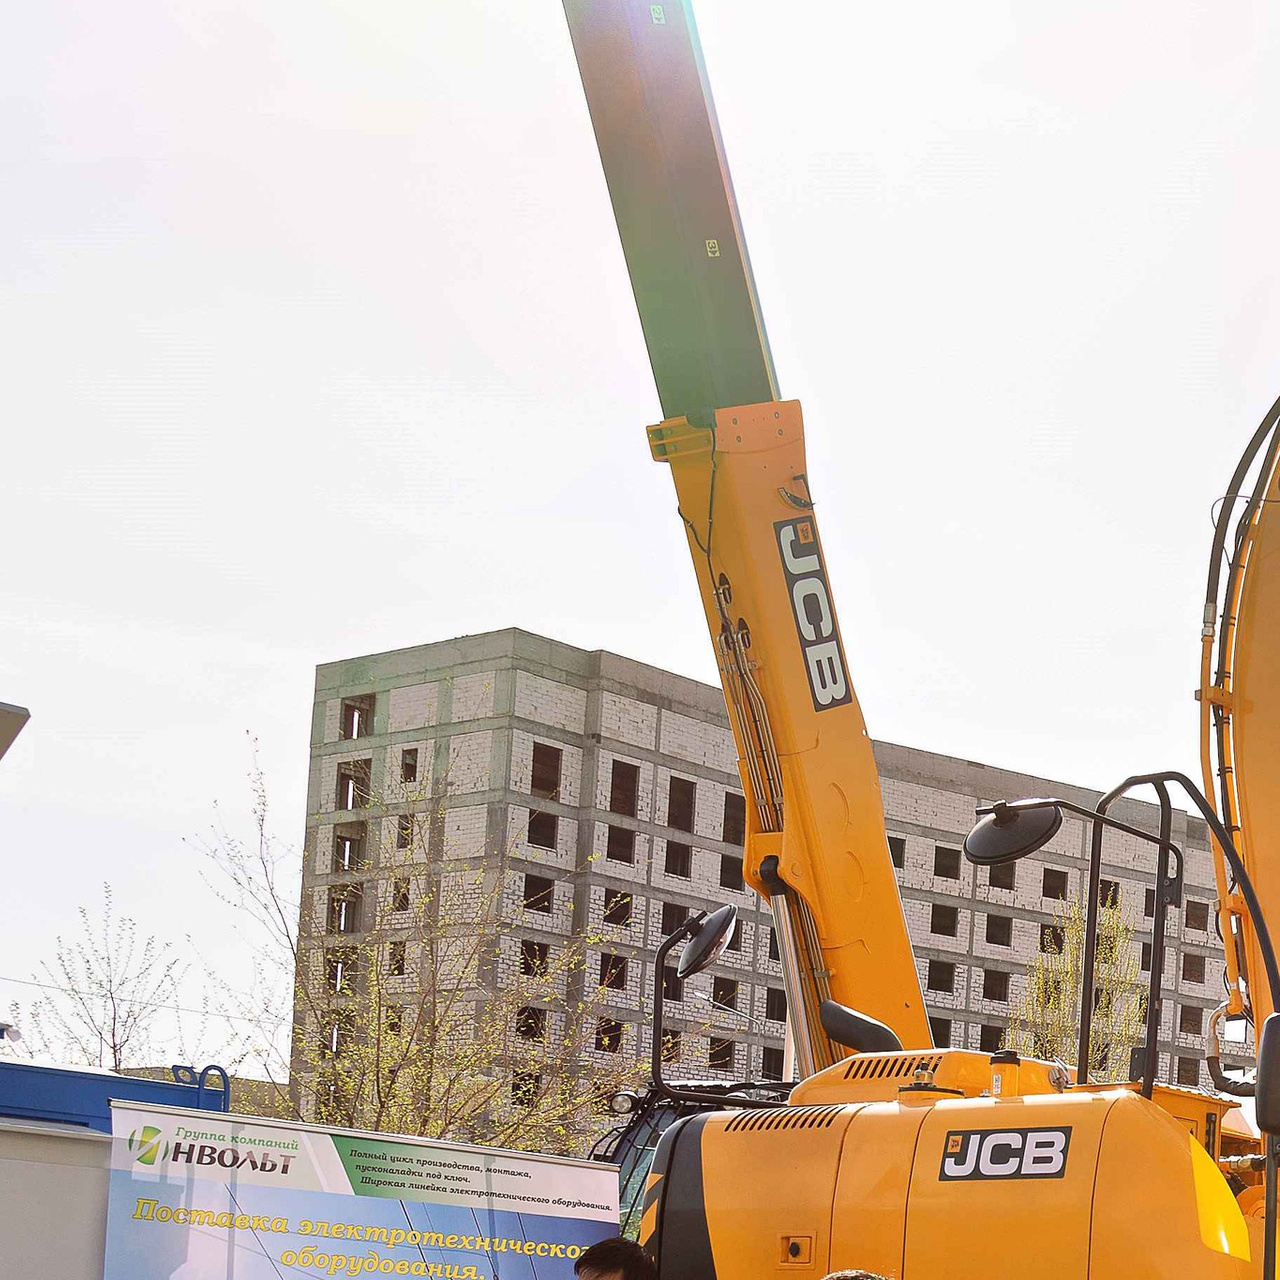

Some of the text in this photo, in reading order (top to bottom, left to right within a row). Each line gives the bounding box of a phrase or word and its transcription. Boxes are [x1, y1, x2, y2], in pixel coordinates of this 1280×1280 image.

[779, 525, 847, 706] JCB
[175, 1126, 299, 1151] Группа компаний
[944, 1131, 1067, 1177] JCB
[349, 1149, 532, 1179] Полный цикл производства, монтажа,
[355, 1164, 471, 1184] пусконаладки под ключ.
[360, 1176, 613, 1212] Широкая линейка электротехнического оборудования.
[132, 1197, 289, 1234] Поставка
[280, 1245, 486, 1280] оборудования.
